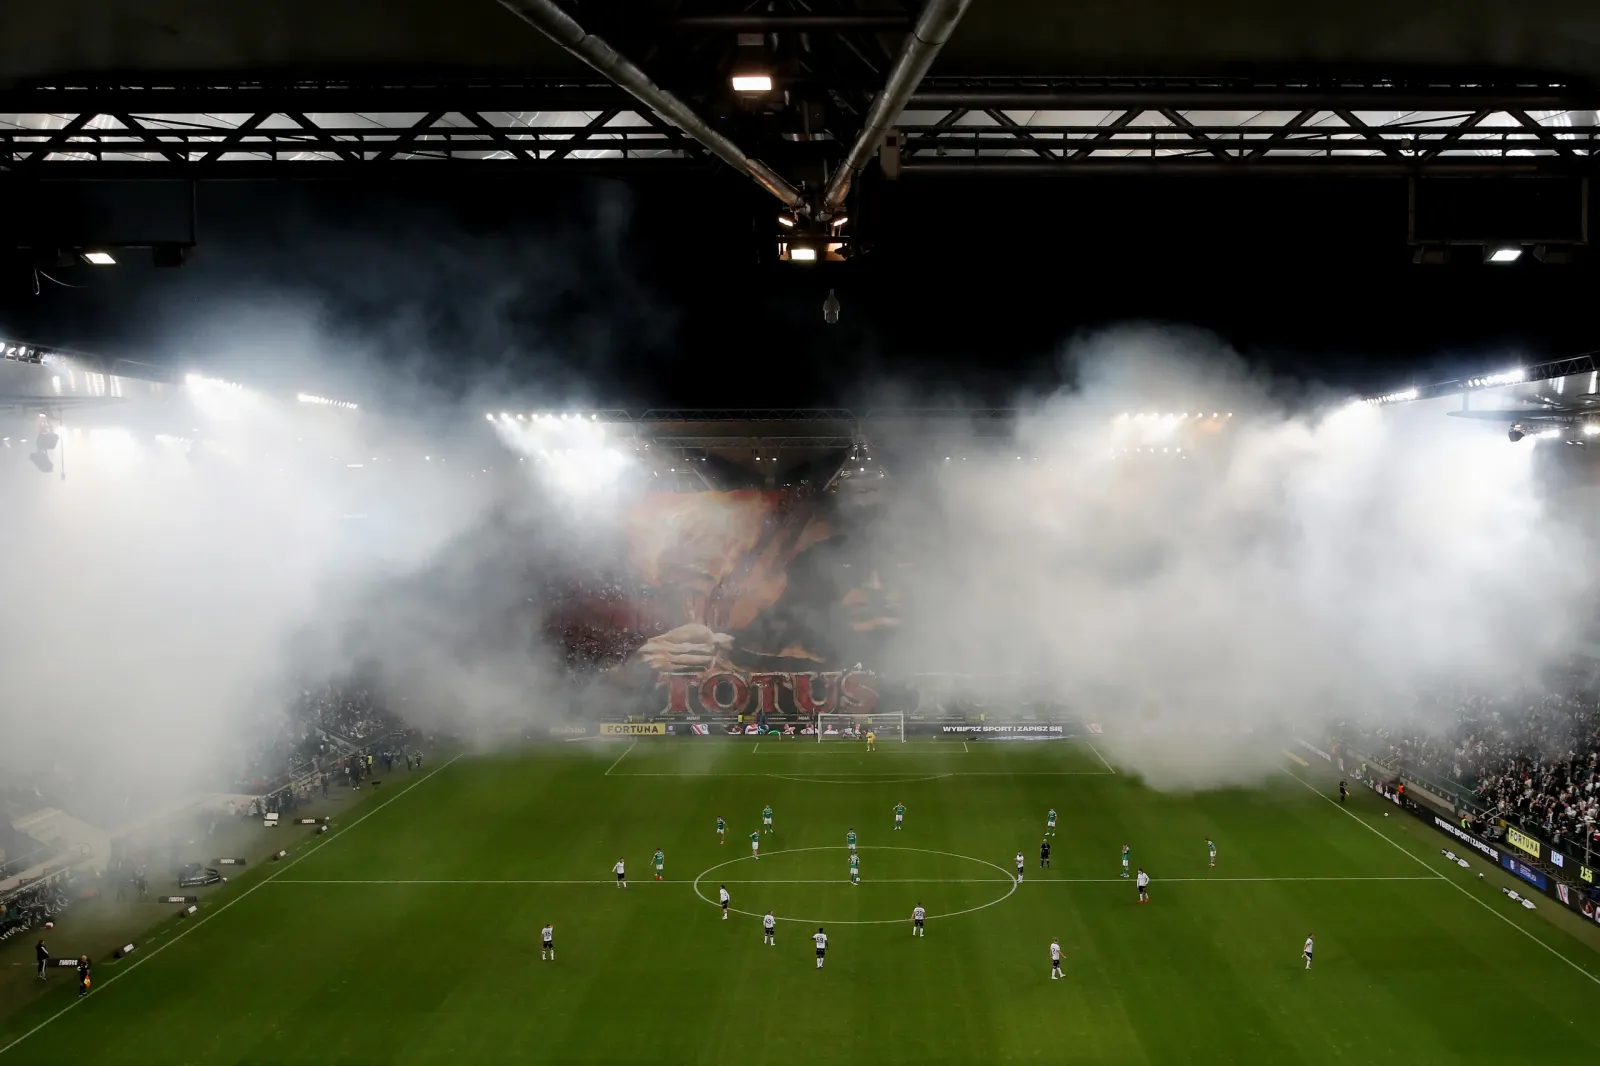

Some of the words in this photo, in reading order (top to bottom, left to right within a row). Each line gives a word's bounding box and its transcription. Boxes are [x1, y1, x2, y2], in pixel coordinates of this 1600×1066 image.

[659, 671, 879, 714] TOTUS
[607, 725, 659, 733] FORTUNA
[1454, 828, 1470, 843] SPORT
[1472, 838, 1490, 854] ZAPISZ
[1509, 828, 1539, 853] FORTUNA
